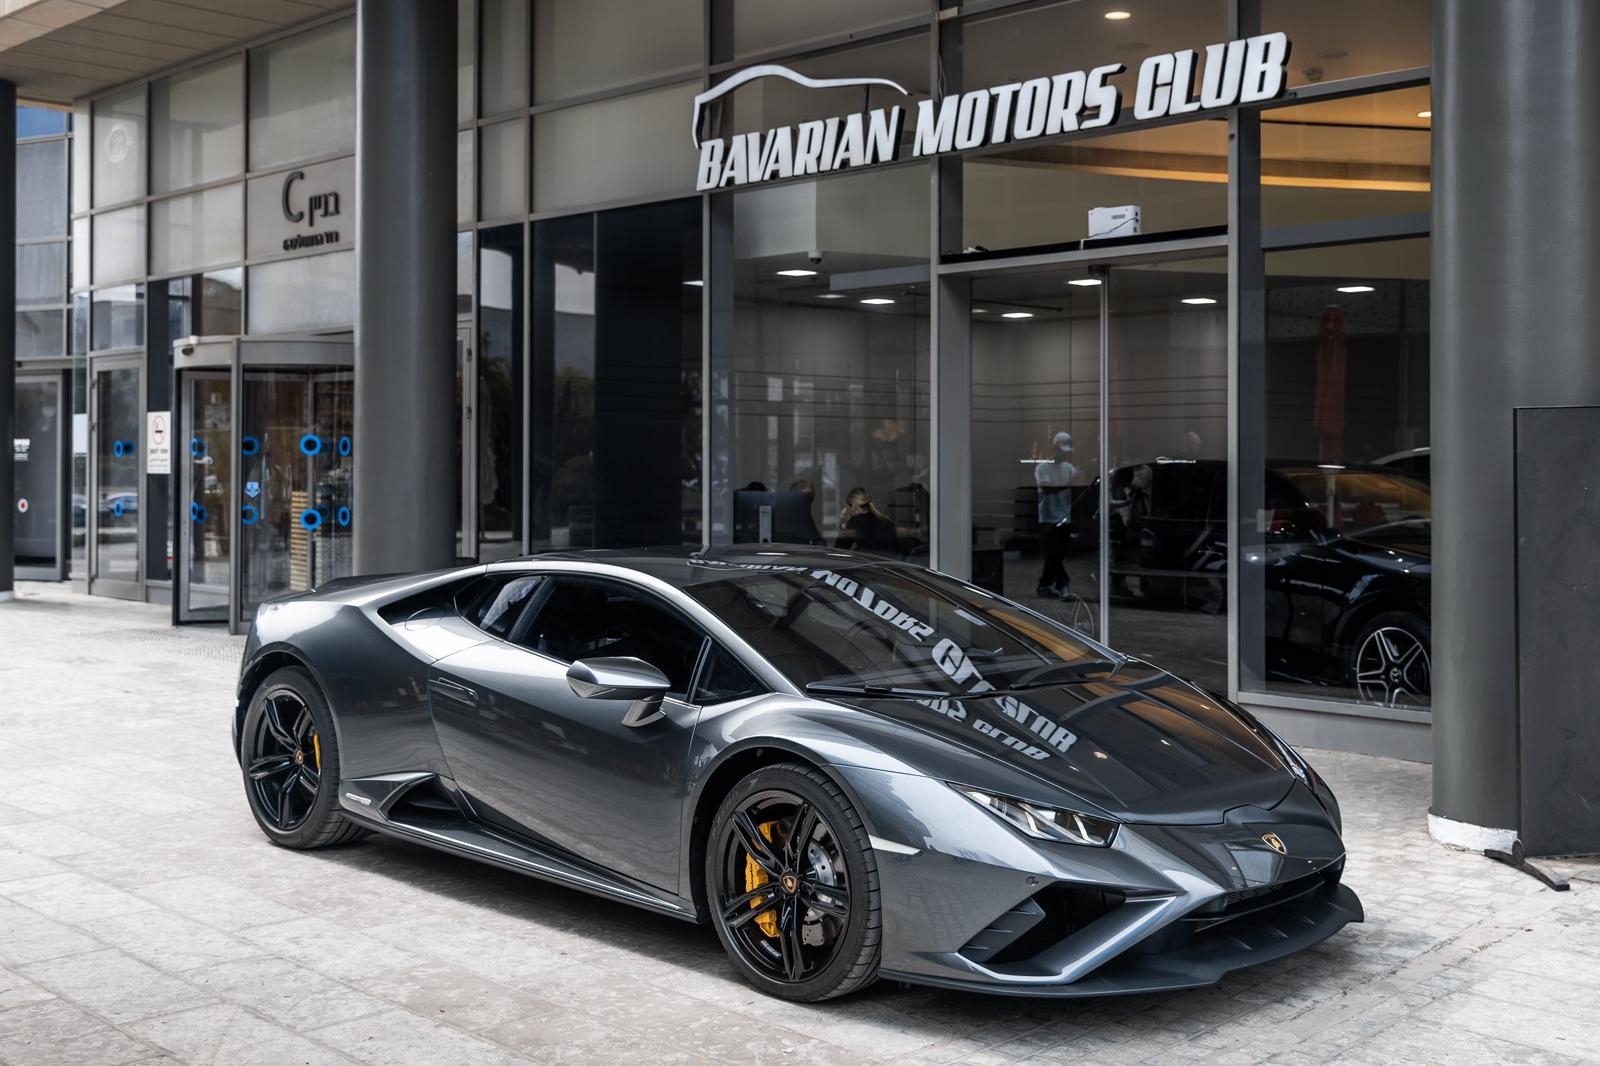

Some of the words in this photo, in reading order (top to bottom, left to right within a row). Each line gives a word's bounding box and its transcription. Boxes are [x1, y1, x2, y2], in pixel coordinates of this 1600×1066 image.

[696, 105, 905, 191] BAVARIAN
[912, 63, 1126, 156] MOTORS
[1133, 32, 1291, 121] CLUB
[282, 170, 304, 223] C
